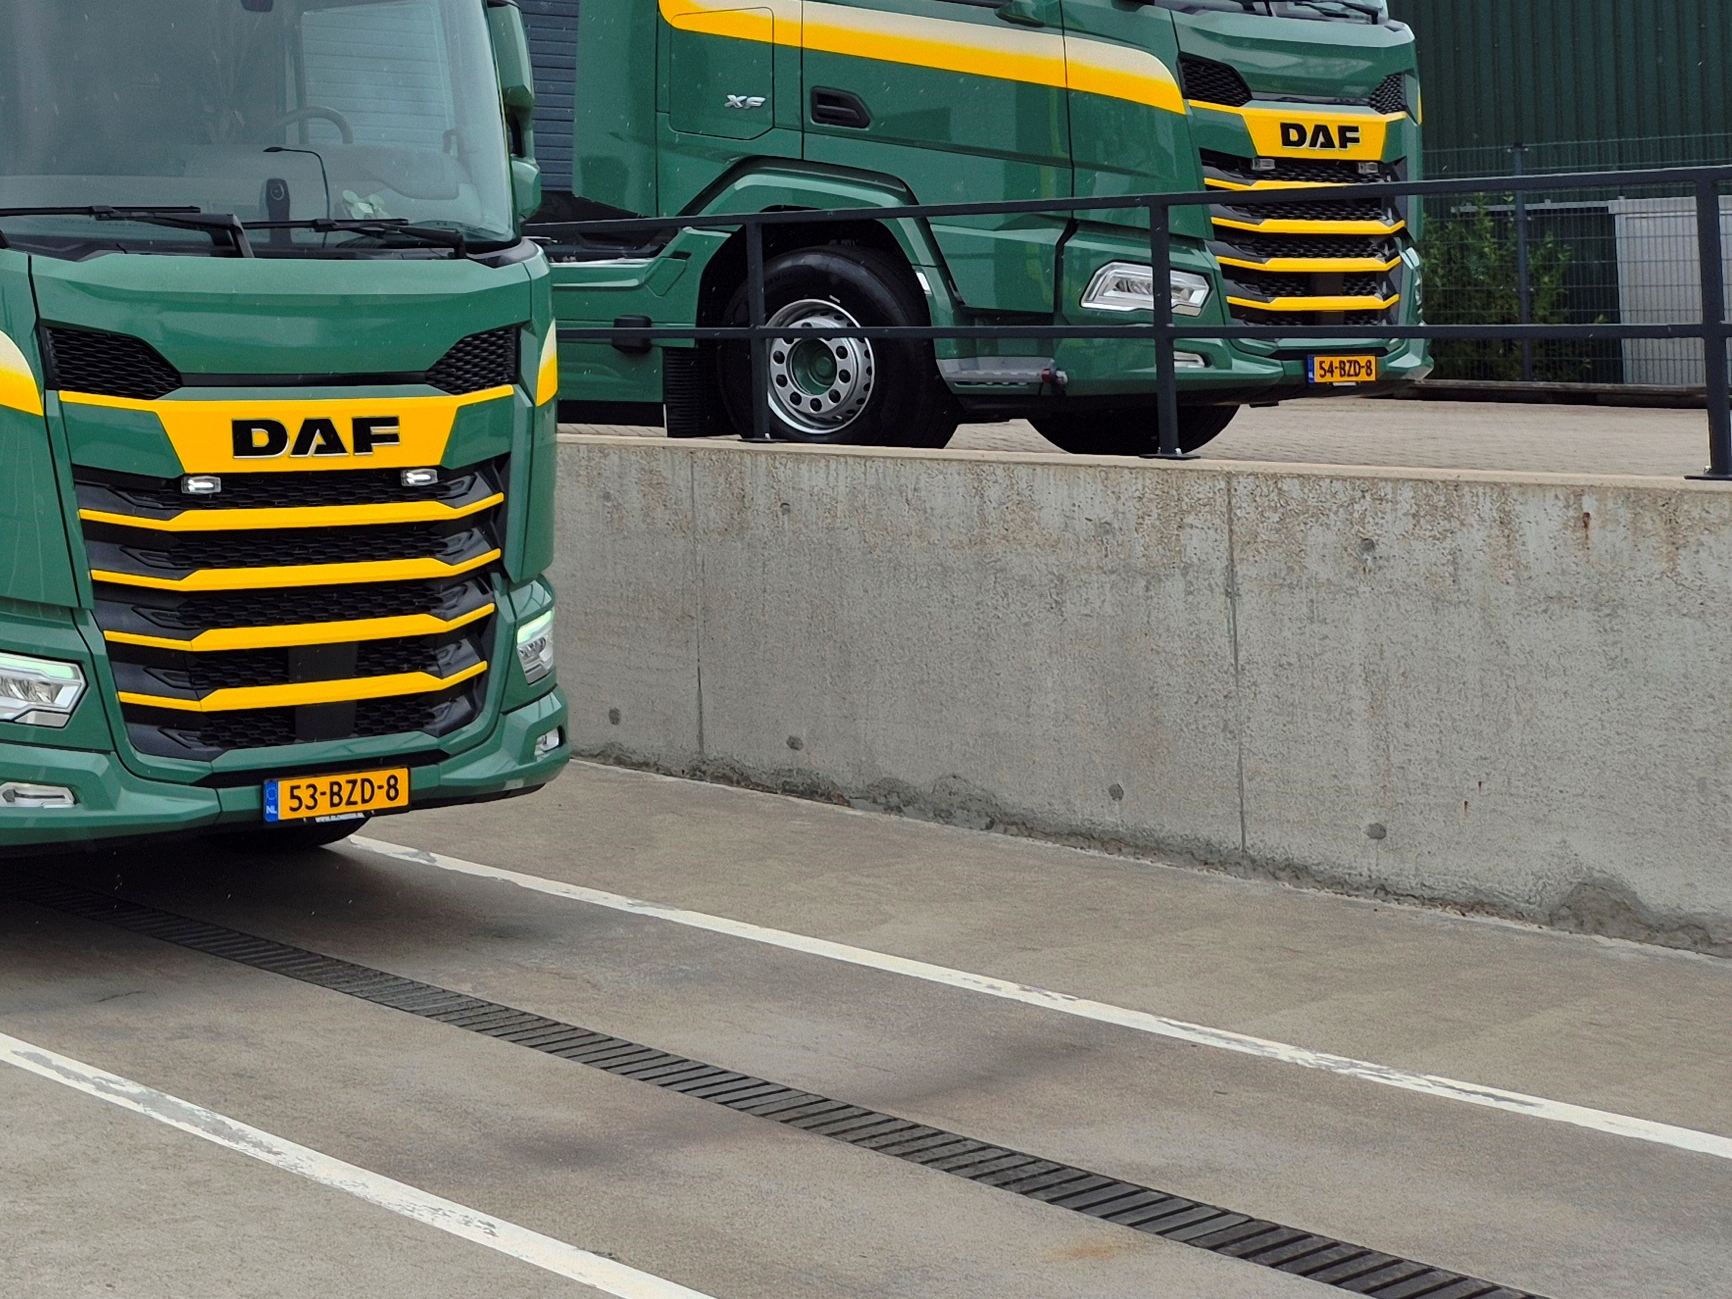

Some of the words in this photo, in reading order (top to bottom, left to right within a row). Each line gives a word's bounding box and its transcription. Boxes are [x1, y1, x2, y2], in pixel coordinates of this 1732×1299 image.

[724, 94, 766, 109] XF
[1280, 122, 1361, 151] DAF
[1318, 359, 1373, 379] 54-BZD-8
[232, 415, 400, 459] DAF
[289, 774, 400, 813] 53-BZD-8
